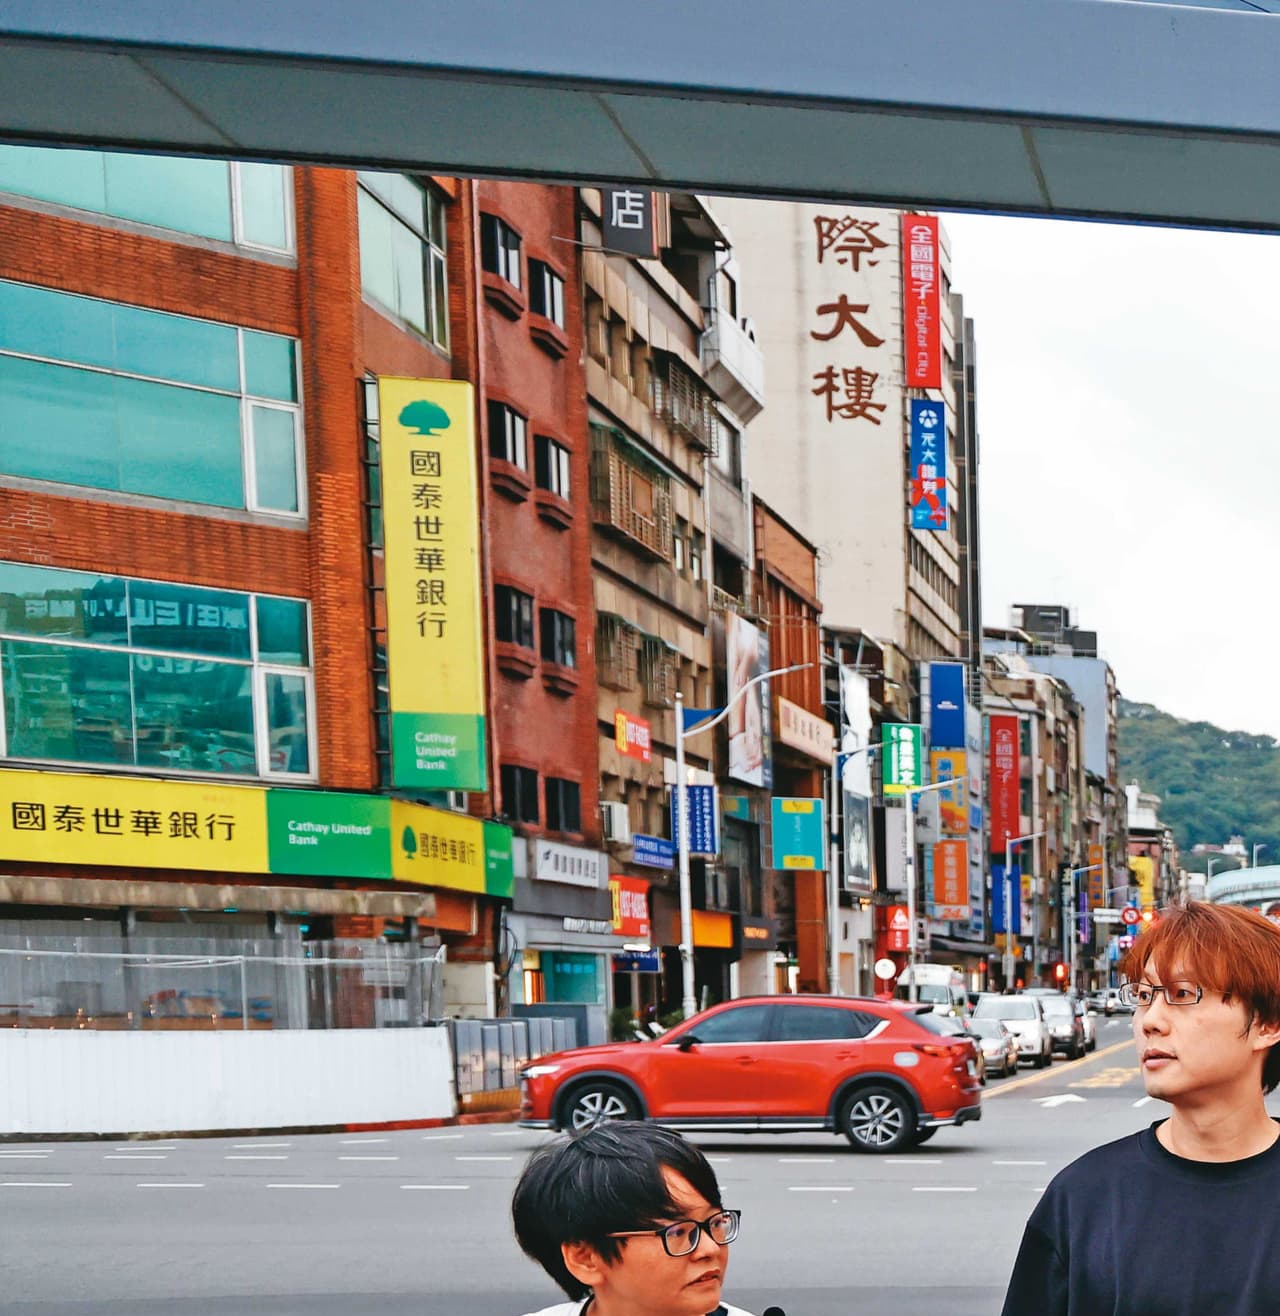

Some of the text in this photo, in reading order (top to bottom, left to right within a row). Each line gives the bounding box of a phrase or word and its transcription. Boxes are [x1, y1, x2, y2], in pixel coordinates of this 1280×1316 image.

[610, 190, 645, 230] 店
[910, 226, 936, 298] 全國電子
[811, 214, 888, 426] 際大樓
[920, 431, 938, 496] 元大證券
[410, 449, 448, 639] 國泰世華銀行
[415, 731, 457, 747] Cathay
[415, 745, 457, 759] United
[416, 758, 447, 771] Bank
[12, 800, 236, 842] 國泰世華銀行
[287, 819, 372, 836] Cathay United
[288, 834, 319, 847] Bank
